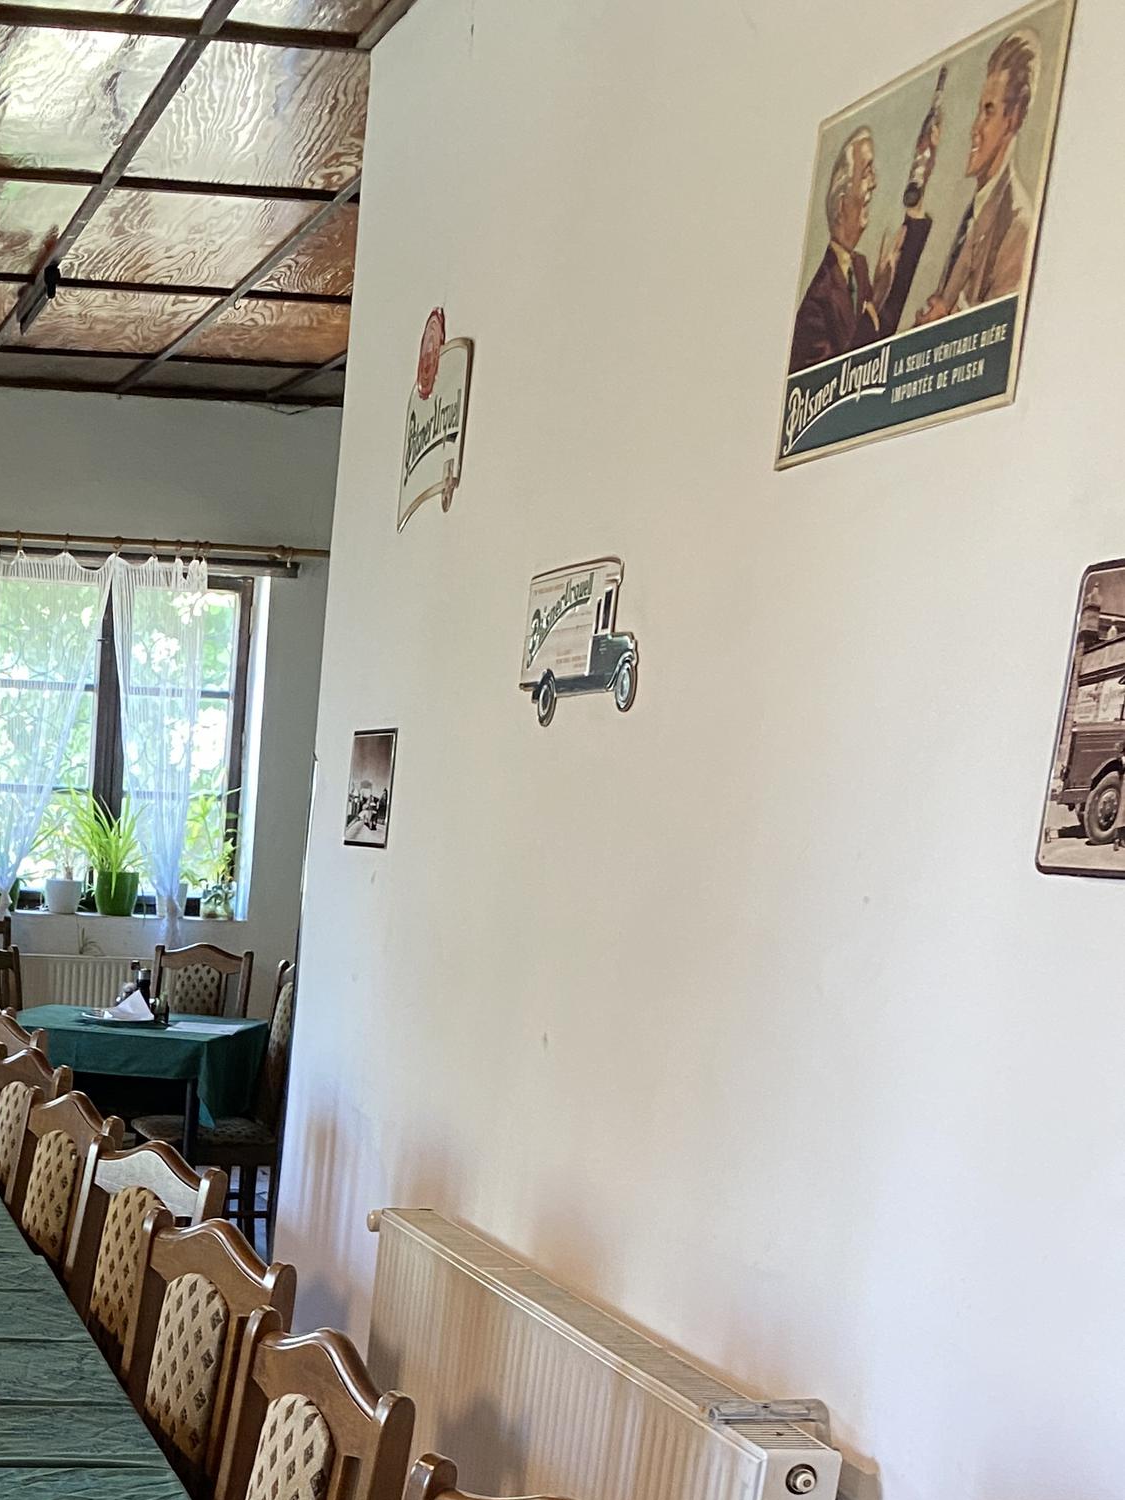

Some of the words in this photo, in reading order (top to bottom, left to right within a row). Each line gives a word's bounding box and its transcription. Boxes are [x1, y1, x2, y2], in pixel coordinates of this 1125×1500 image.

[893, 360, 904, 377] LA
[905, 350, 931, 374] SEULE
[933, 334, 978, 365] VÉRITABLE
[783, 378, 837, 456] Pilsner
[839, 343, 891, 402] Urquell
[891, 374, 933, 404] IMPORTÉE
[936, 371, 950, 387] DE
[951, 358, 985, 386] PILSEN
